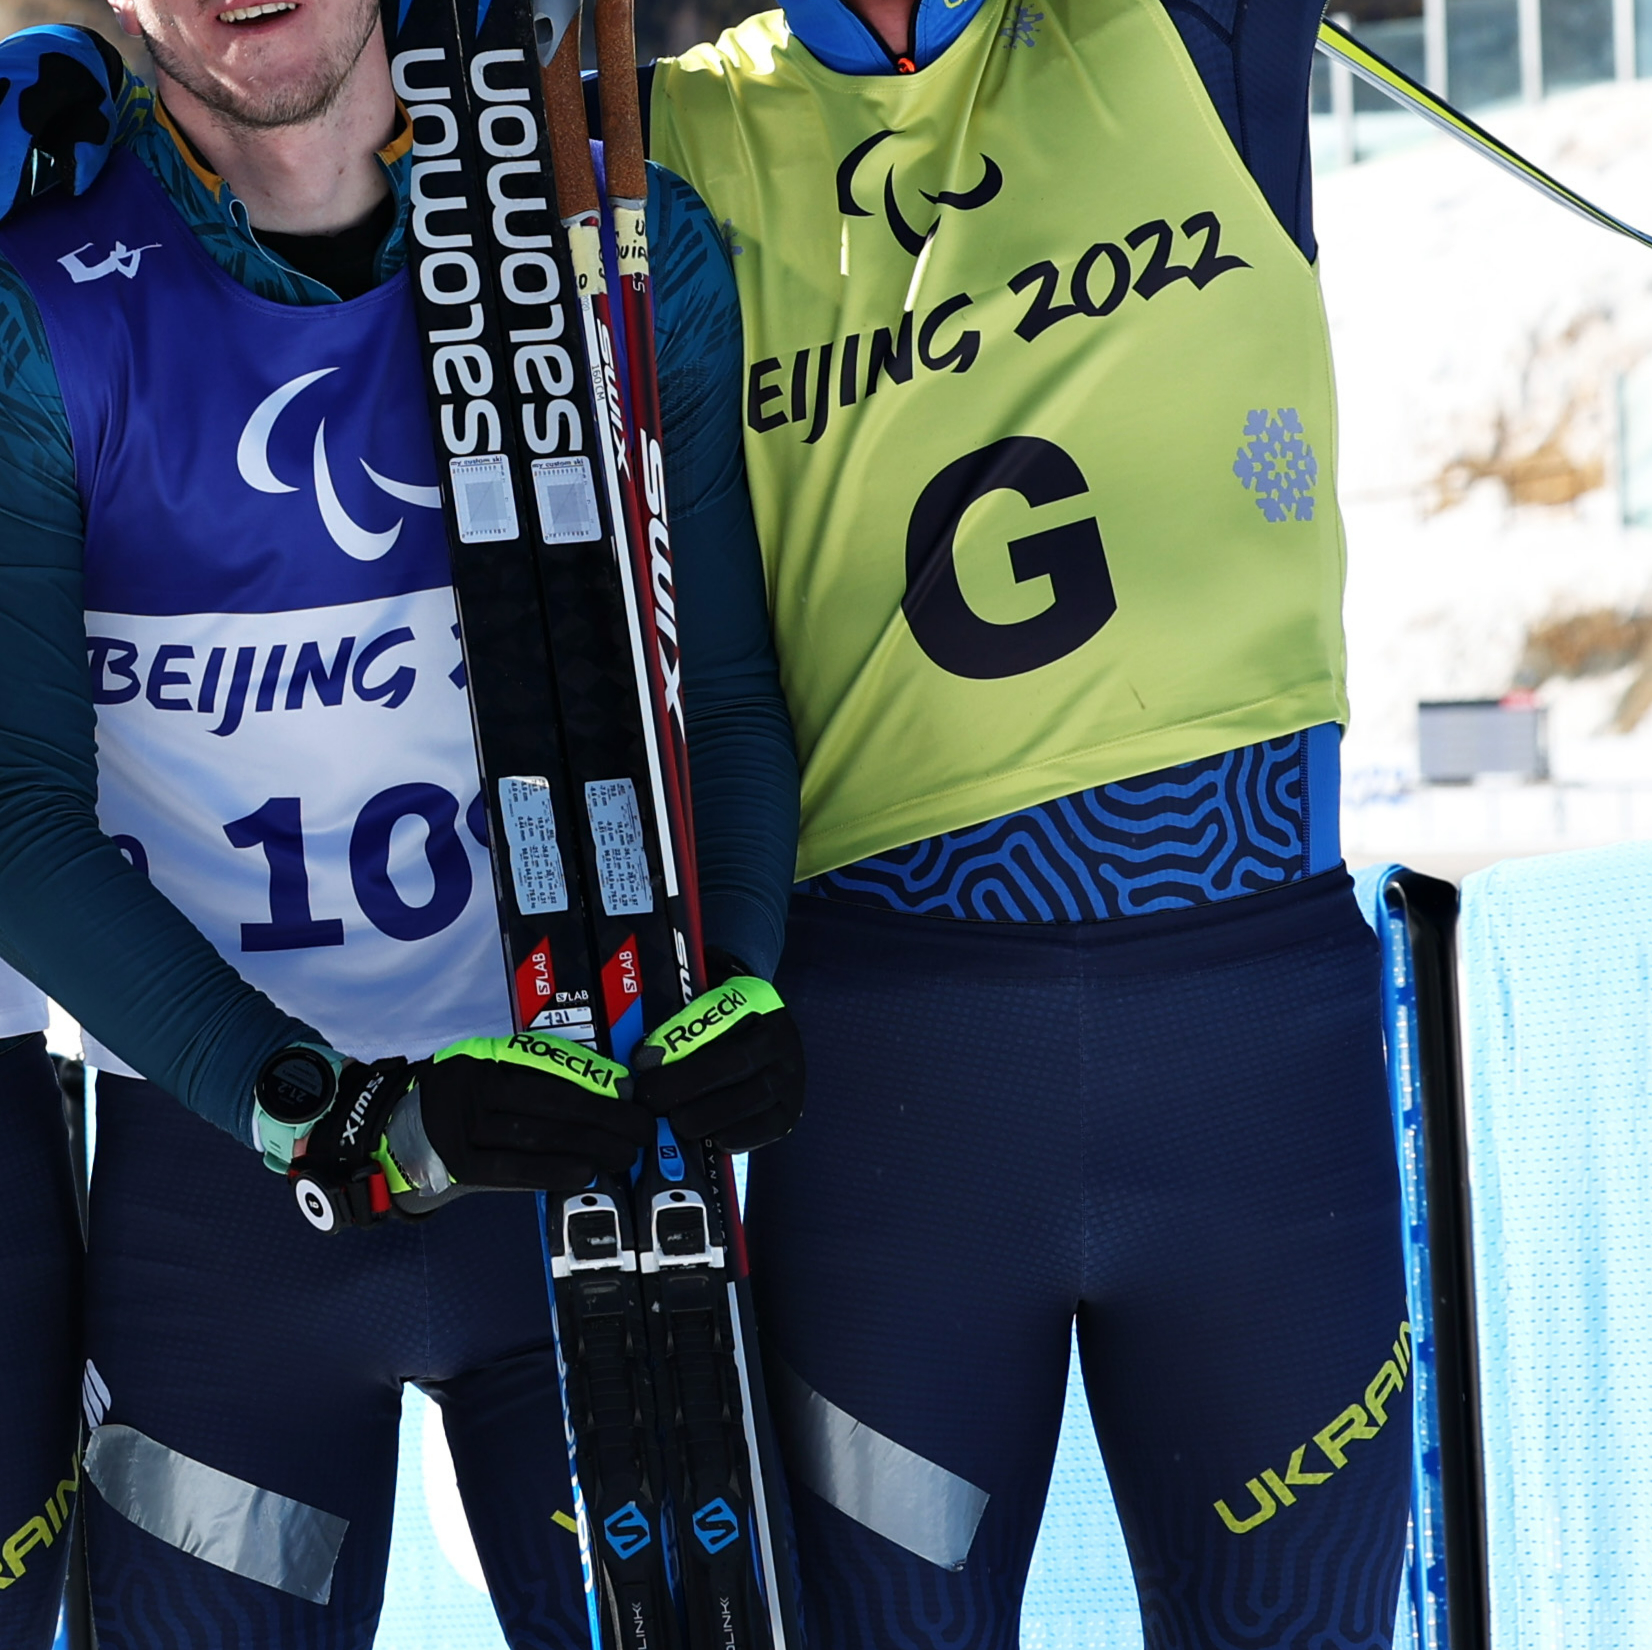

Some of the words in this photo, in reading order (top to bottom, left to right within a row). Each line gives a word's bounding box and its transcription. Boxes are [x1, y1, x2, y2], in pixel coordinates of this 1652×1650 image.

[745, 295, 984, 446] EIJING
[1009, 210, 1255, 344] 2022
[900, 436, 1118, 681] G
[87, 625, 418, 738] BEIJING
[223, 781, 487, 953] 10
[1213, 1320, 1412, 1534] UKRAIN
